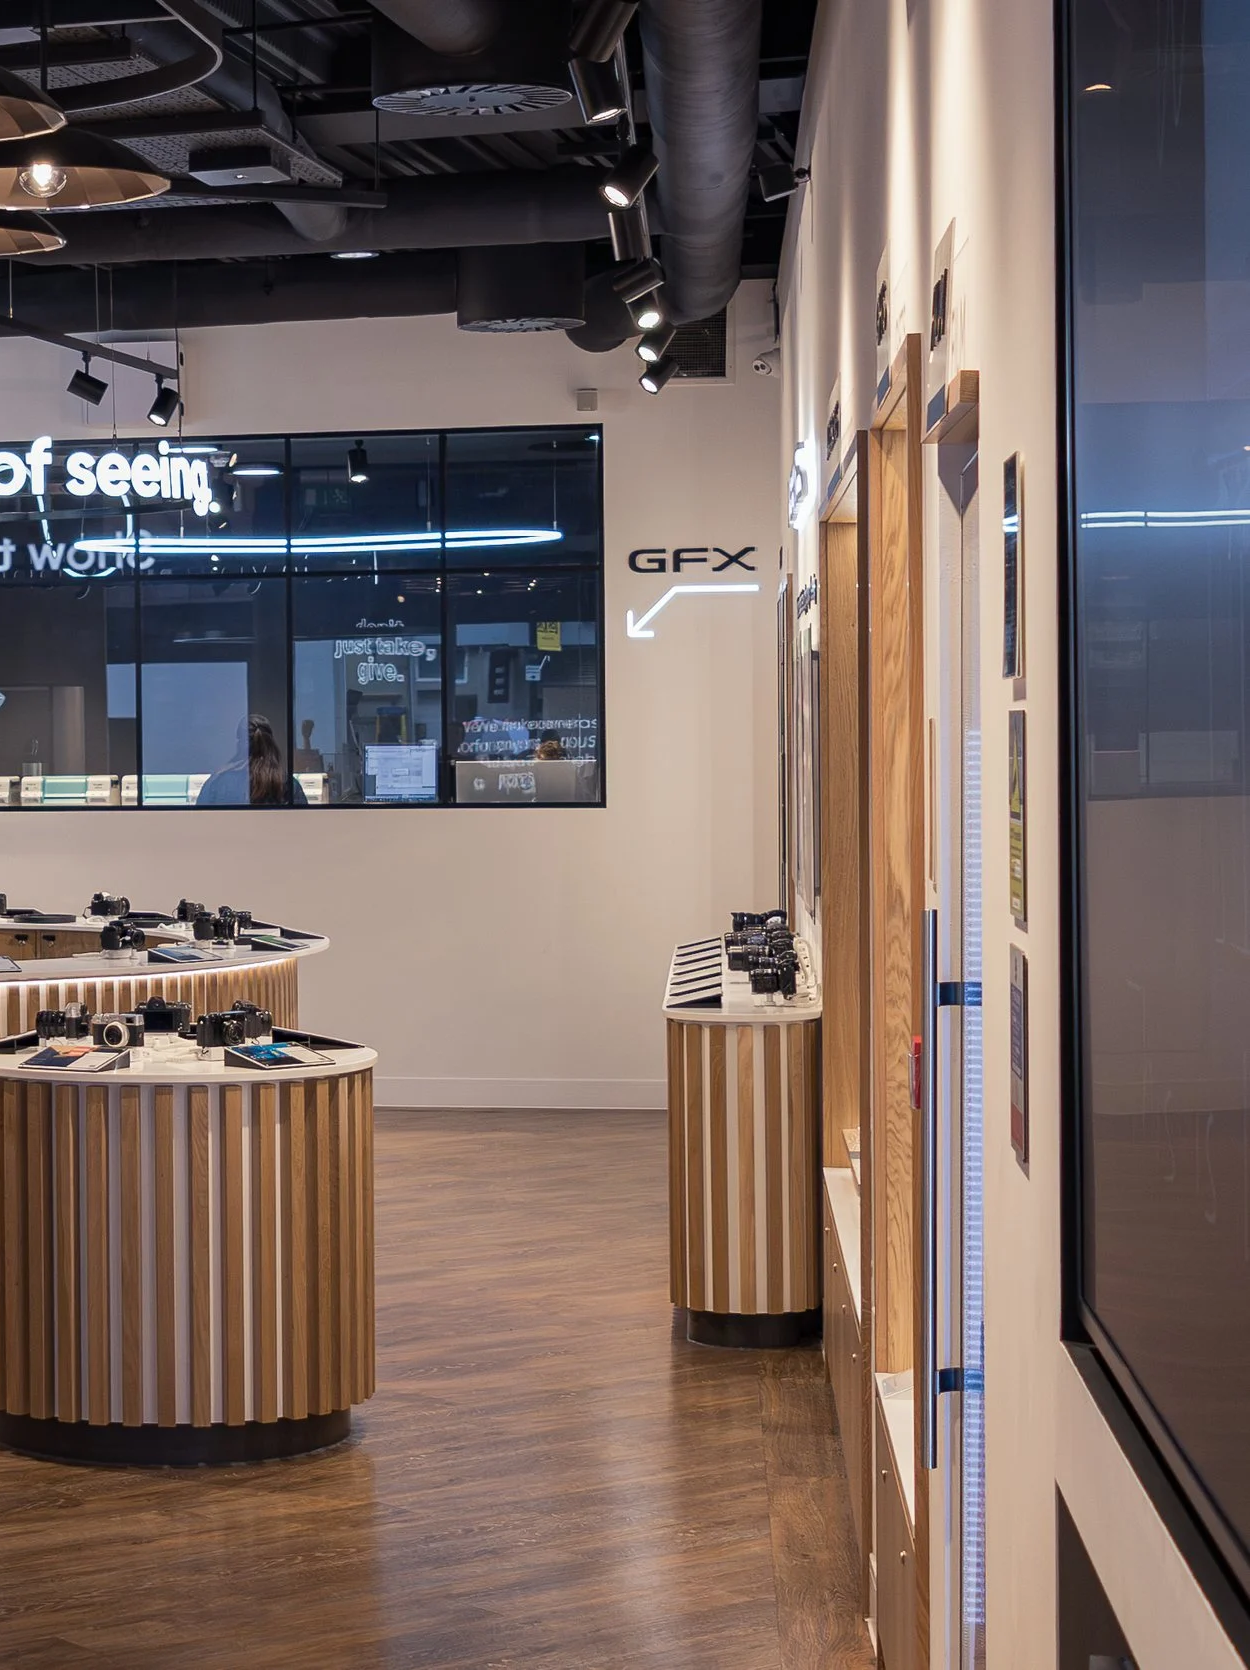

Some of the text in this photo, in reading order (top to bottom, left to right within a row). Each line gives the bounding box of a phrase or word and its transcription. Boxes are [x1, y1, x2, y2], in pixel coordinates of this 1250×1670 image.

[628, 547, 756, 573] GFX
[334, 638, 372, 658] just
[357, 656, 405, 685] give.
